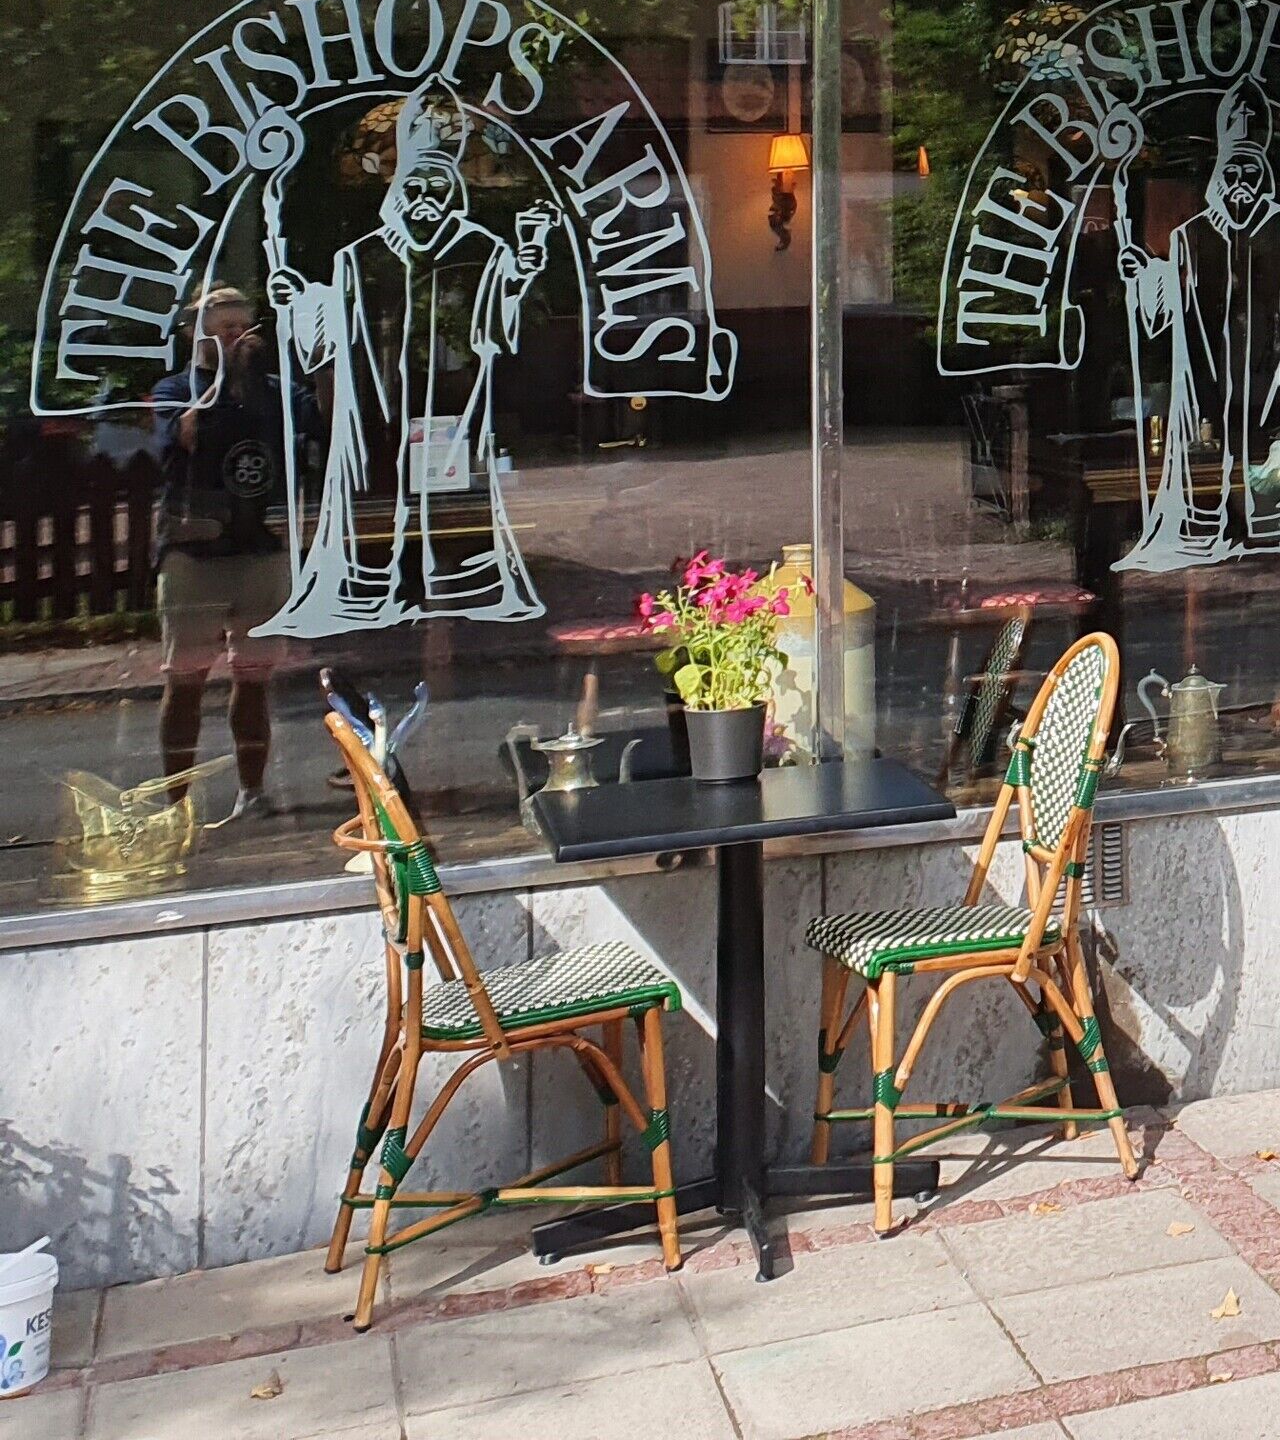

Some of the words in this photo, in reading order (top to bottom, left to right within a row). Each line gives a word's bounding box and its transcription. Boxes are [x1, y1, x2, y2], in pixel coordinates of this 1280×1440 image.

[56, 176, 214, 382] THE
[538, 100, 701, 363] ARMS
[955, 168, 1075, 347] THE
